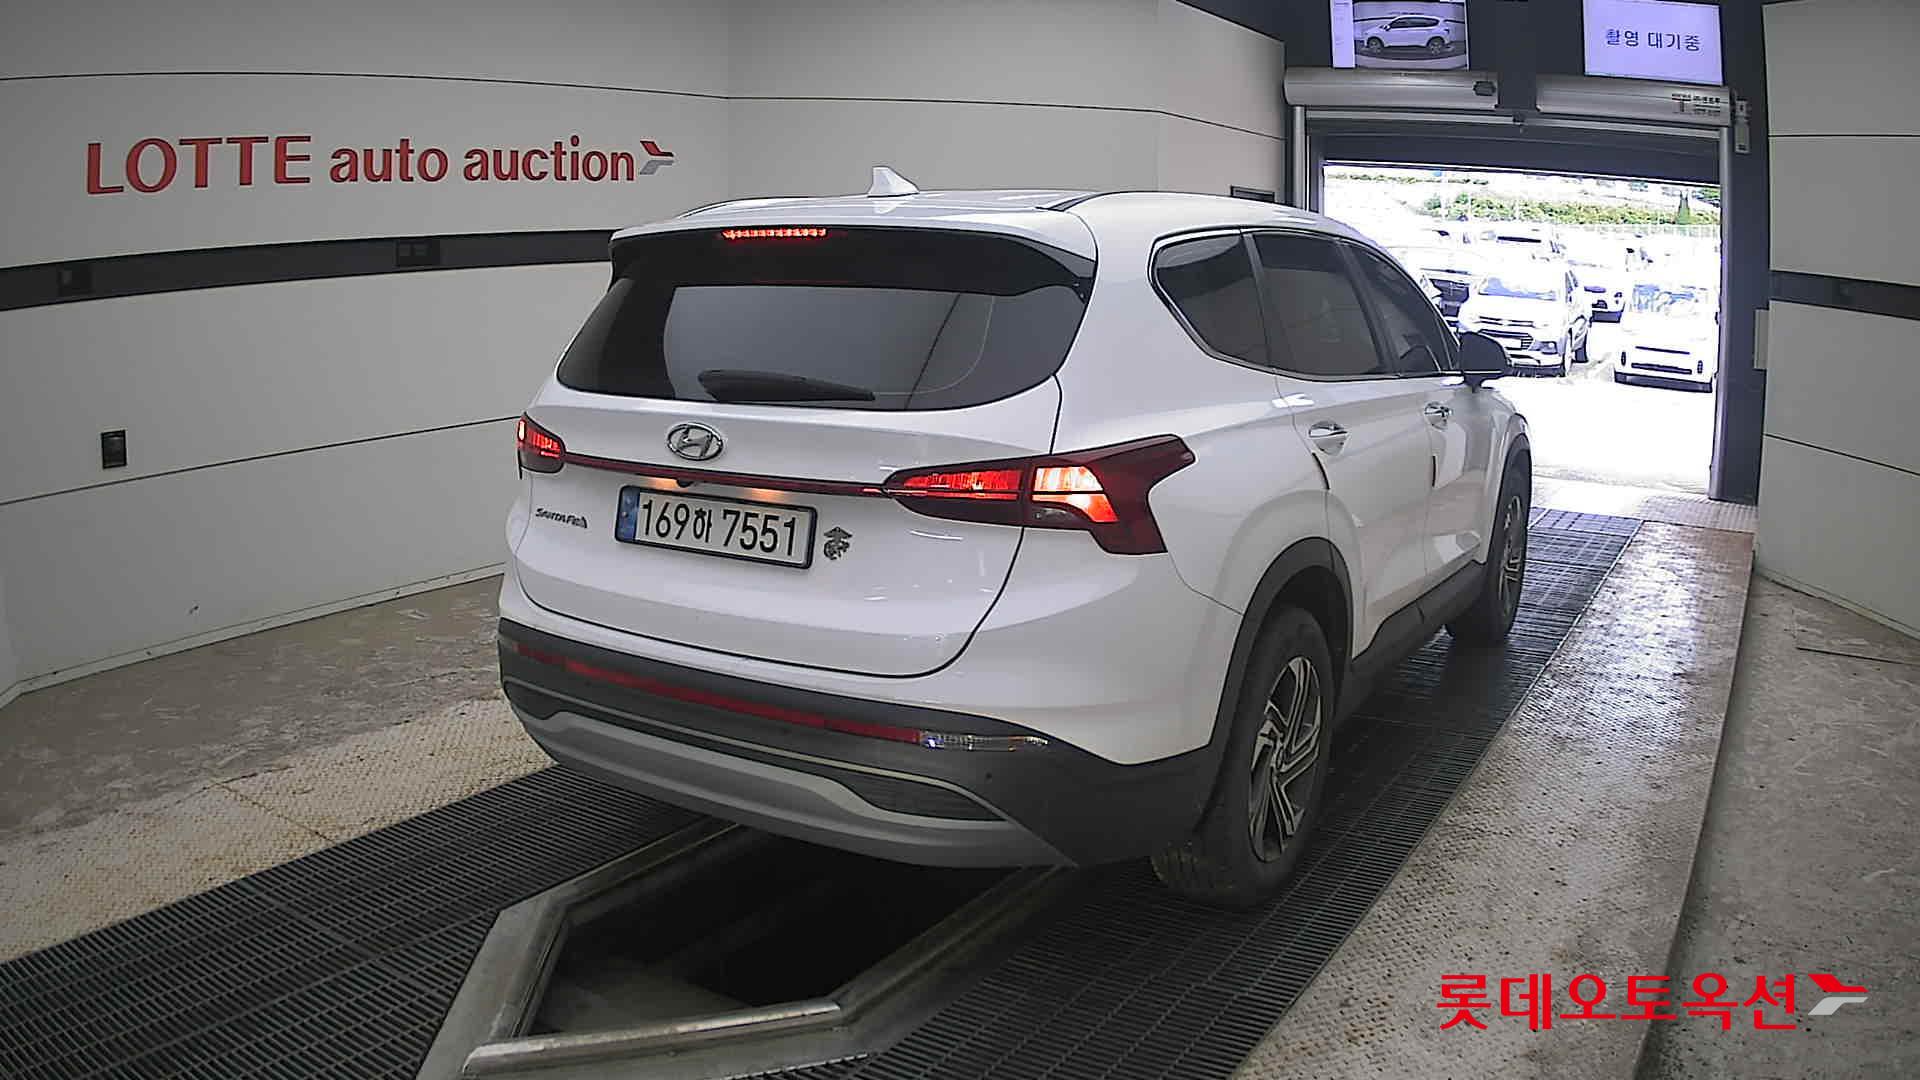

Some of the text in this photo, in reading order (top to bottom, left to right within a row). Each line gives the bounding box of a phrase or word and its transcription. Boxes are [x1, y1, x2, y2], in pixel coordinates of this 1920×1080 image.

[1648, 32, 1701, 52] 대기중
[86, 135, 635, 195] LOTTE auto auction
[642, 499, 796, 556] 169하 7551
